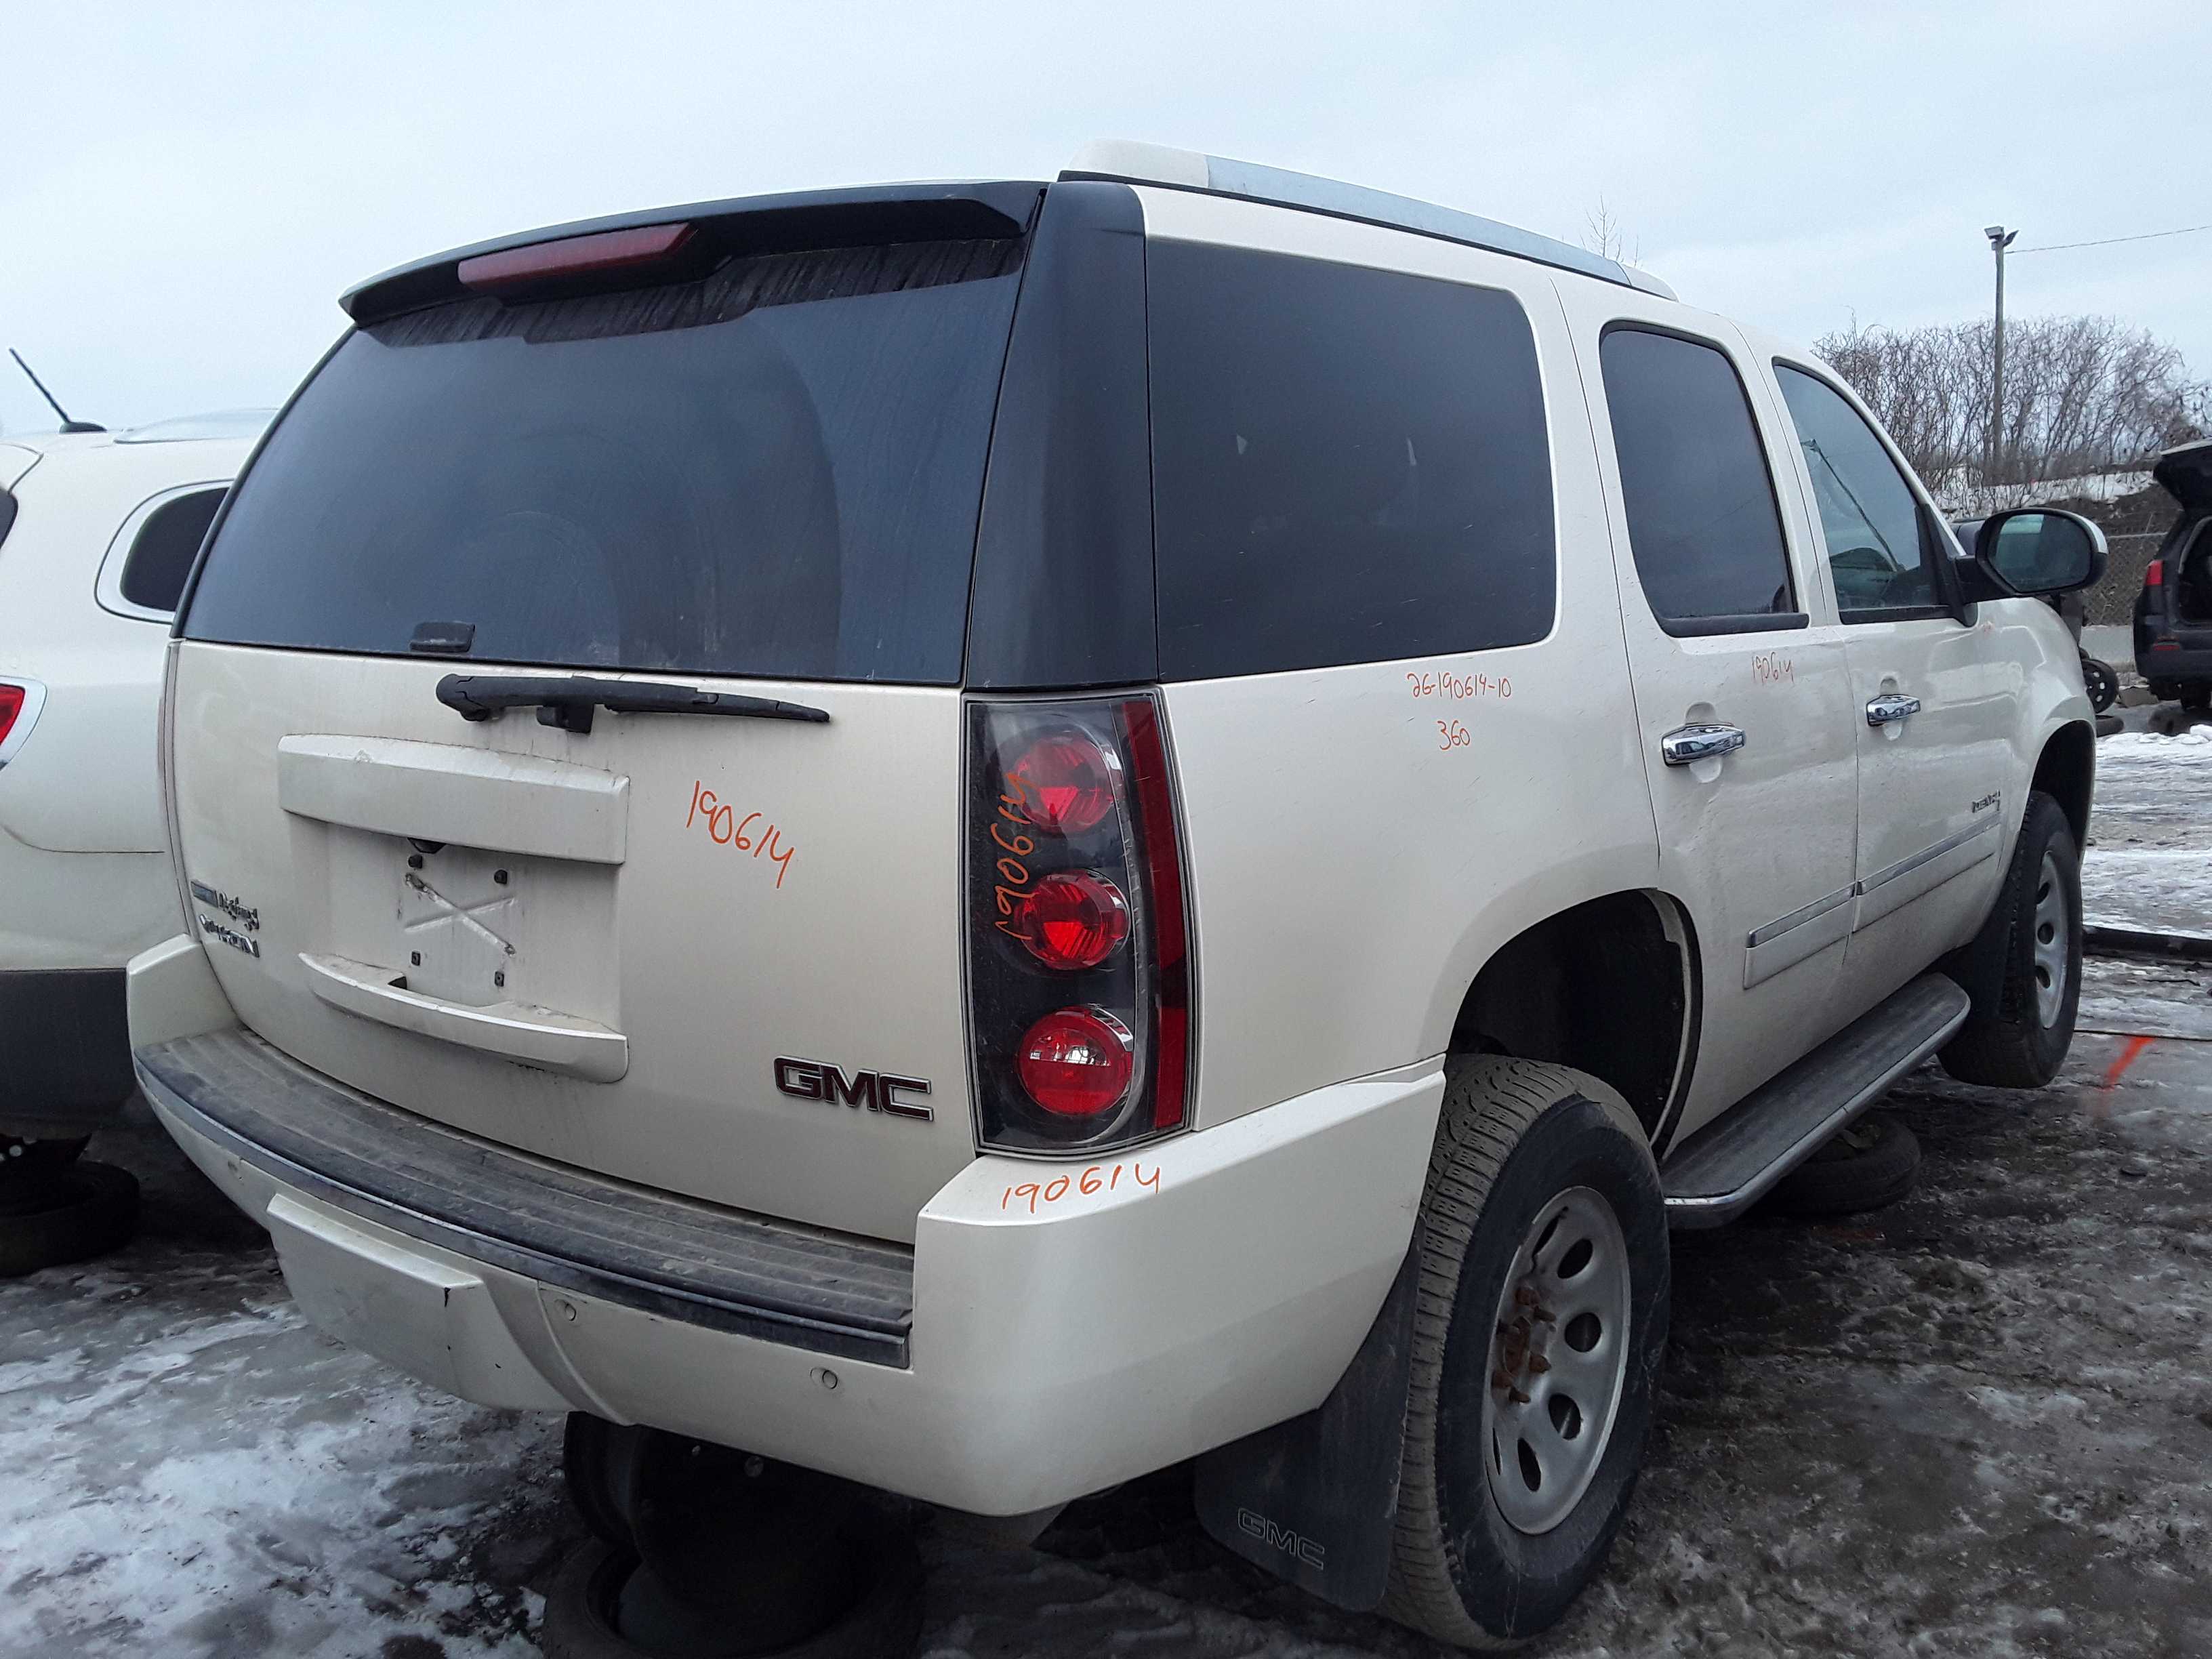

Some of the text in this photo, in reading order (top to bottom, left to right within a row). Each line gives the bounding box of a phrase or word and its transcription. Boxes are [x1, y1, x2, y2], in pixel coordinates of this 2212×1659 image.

[1437, 720, 1471, 750] 360
[686, 780, 795, 889] 190614
[991, 773, 1038, 941] 190614
[773, 1054, 934, 1122] GMC
[1002, 1163, 1161, 1214] 190614
[1237, 1507, 1326, 1571] GMC
